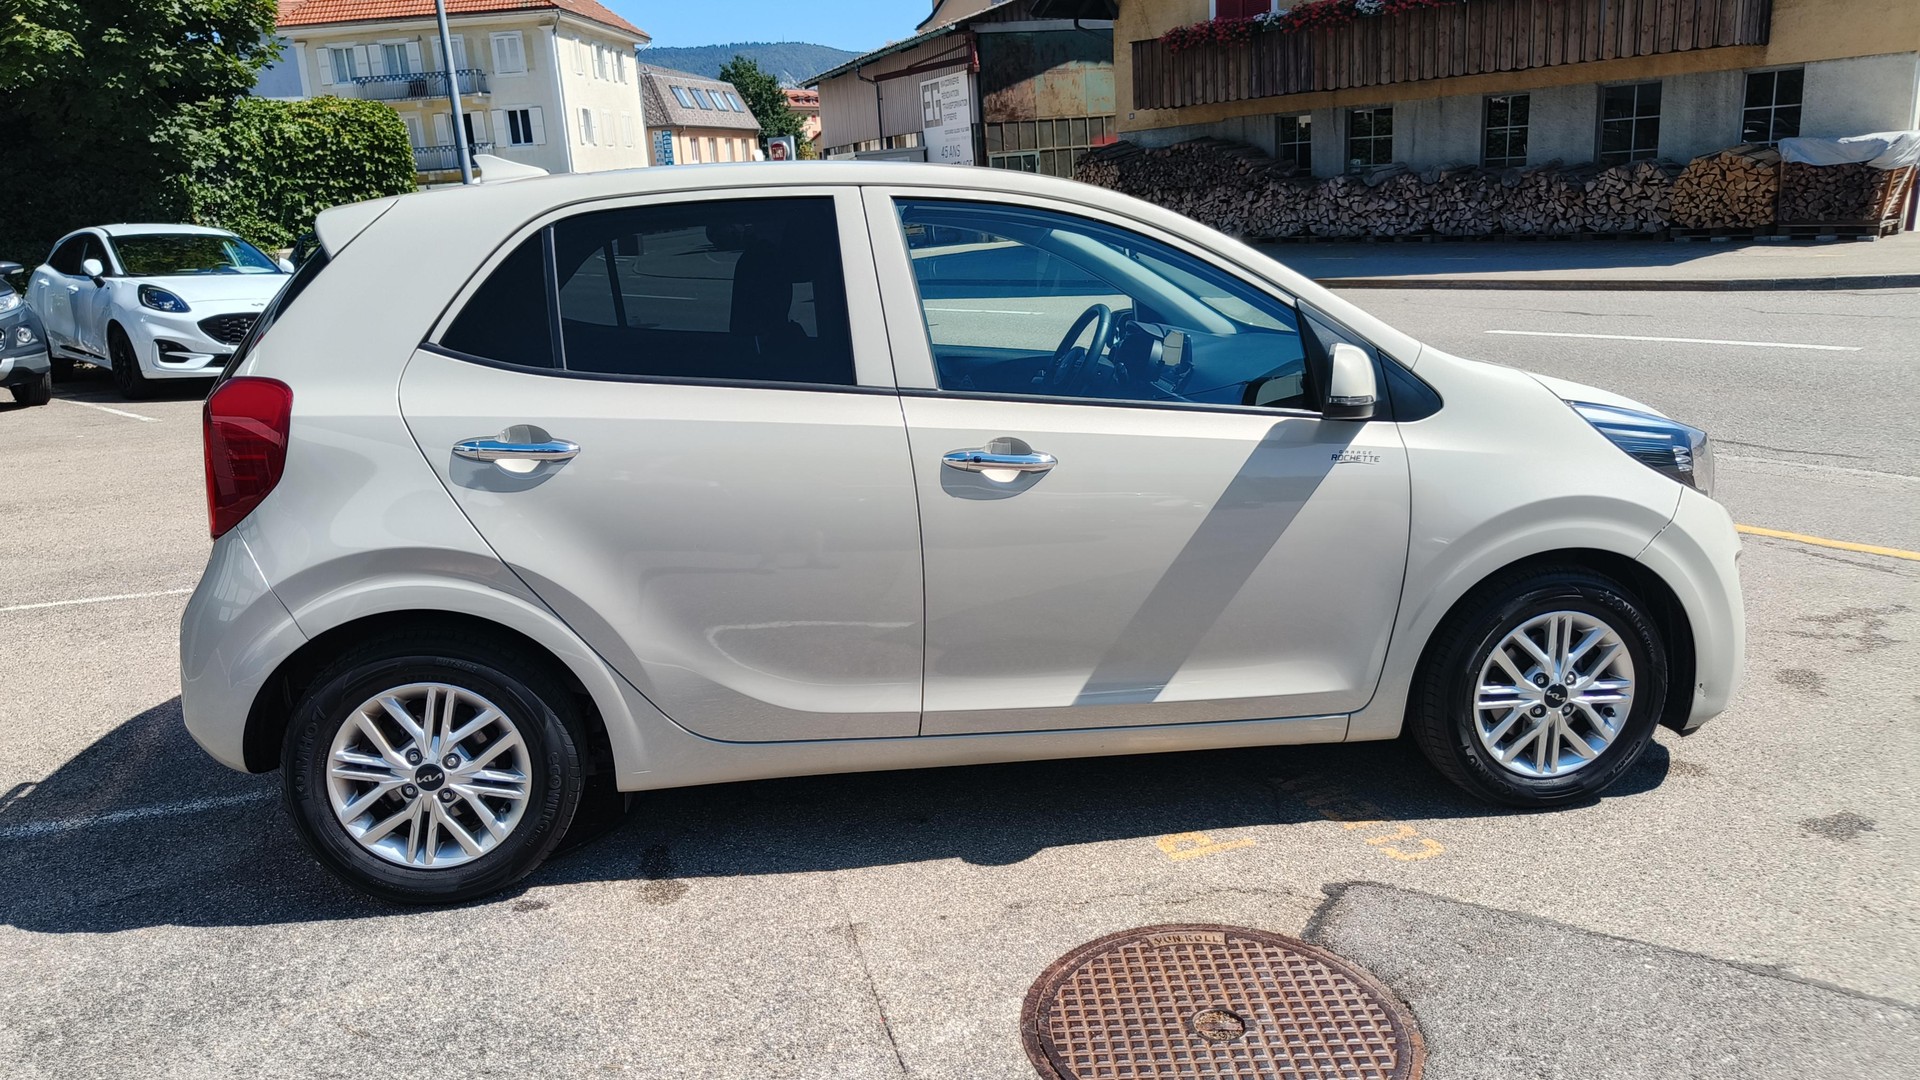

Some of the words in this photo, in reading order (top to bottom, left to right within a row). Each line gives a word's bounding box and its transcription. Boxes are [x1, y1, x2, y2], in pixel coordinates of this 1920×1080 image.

[921, 82, 943, 128] EG
[941, 146, 949, 158] 45
[949, 145, 960, 157] ANS
[1331, 454, 1381, 463] ROCHETTE
[1154, 934, 1182, 945] VON
